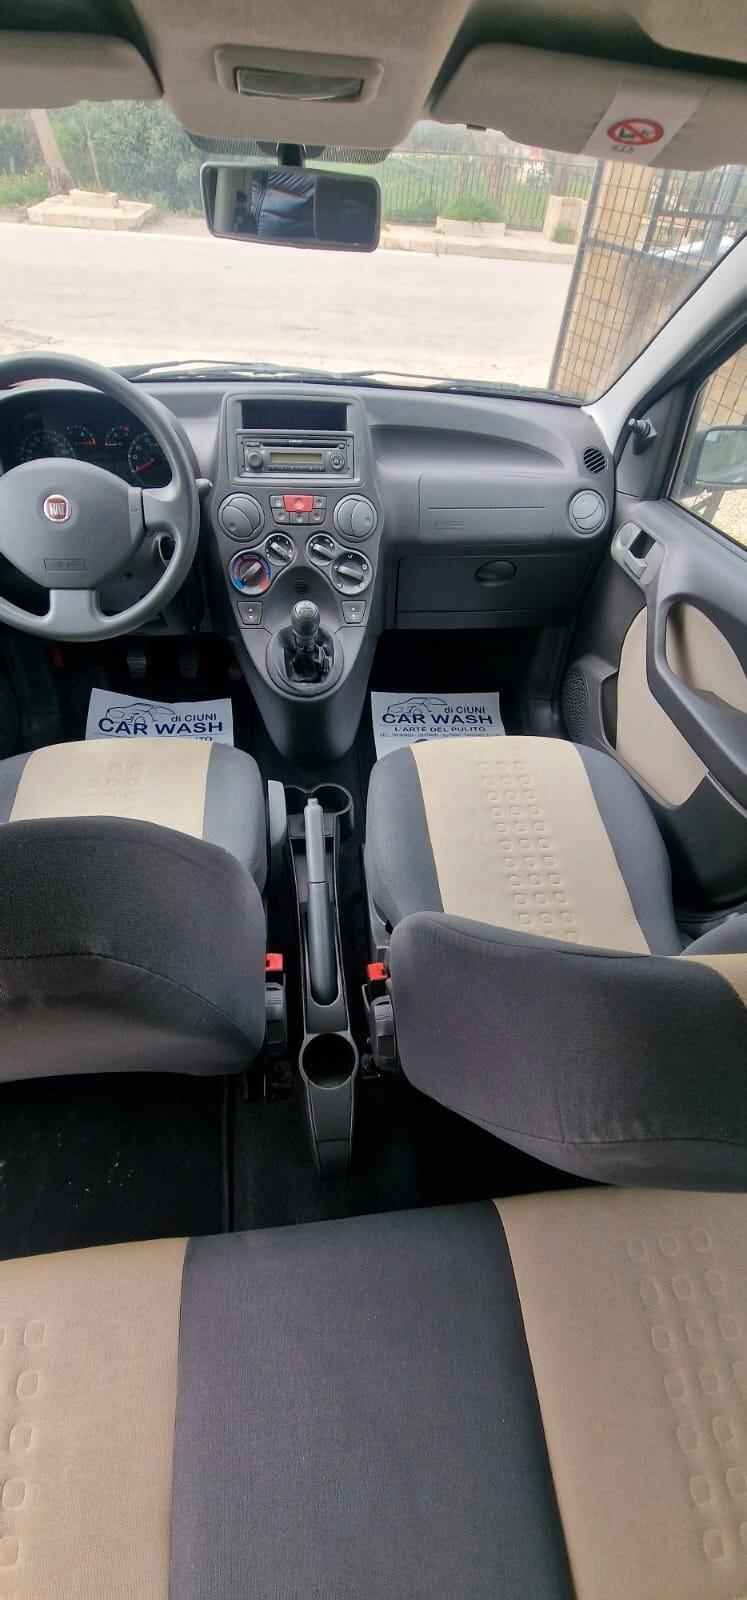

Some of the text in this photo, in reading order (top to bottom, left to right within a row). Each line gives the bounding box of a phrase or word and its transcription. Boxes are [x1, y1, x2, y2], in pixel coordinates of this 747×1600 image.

[444, 706, 486, 714] di CIUNI
[184, 713, 217, 722] CIUNI
[382, 713, 493, 725] CAR WASH
[98, 718, 223, 735] CAR WASH
